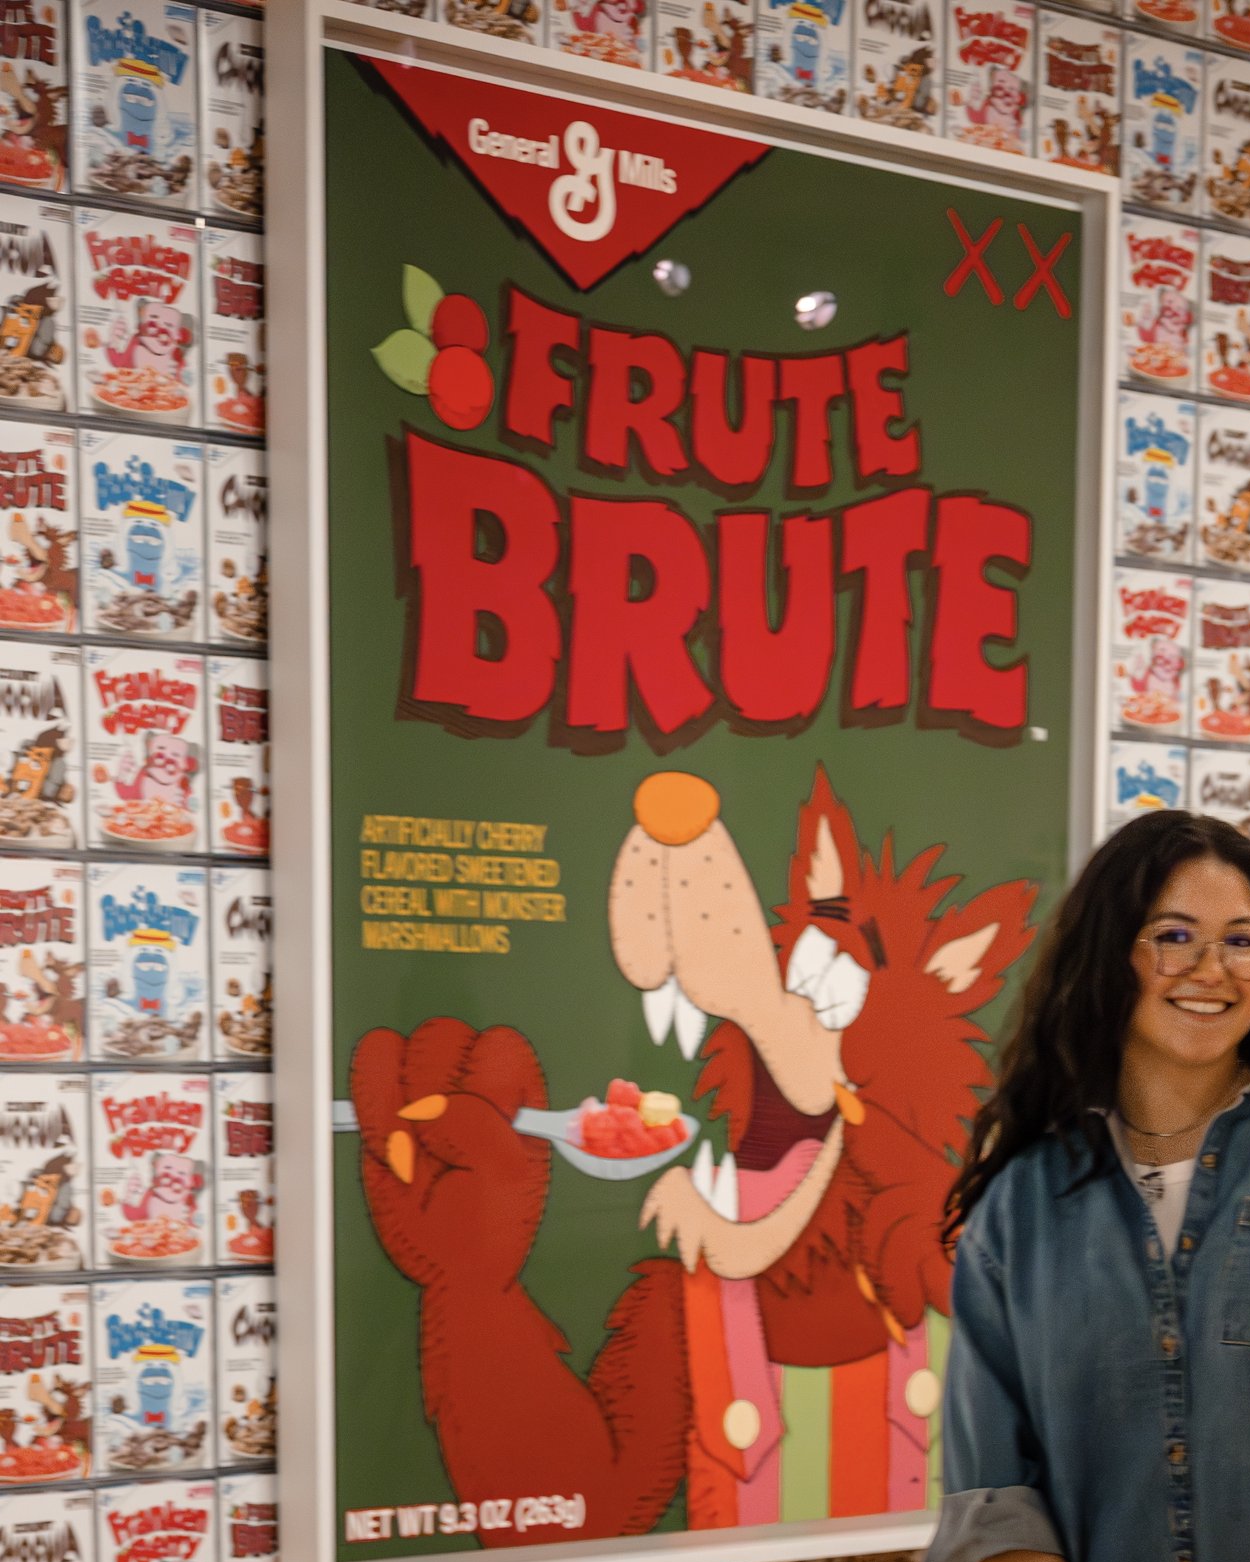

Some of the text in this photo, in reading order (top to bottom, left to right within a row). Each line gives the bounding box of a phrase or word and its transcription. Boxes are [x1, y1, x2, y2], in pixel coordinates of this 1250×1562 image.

[467, 117, 560, 169] General
[617, 149, 678, 194] Mills
[499, 282, 923, 493] FRUTE
[391, 423, 1034, 745] BRUTE
[475, 820, 549, 853] CHERRY
[345, 1508, 394, 1541] NET
[396, 1504, 438, 1538] WT
[438, 1502, 478, 1535] 9.3
[479, 1498, 513, 1530] OZ
